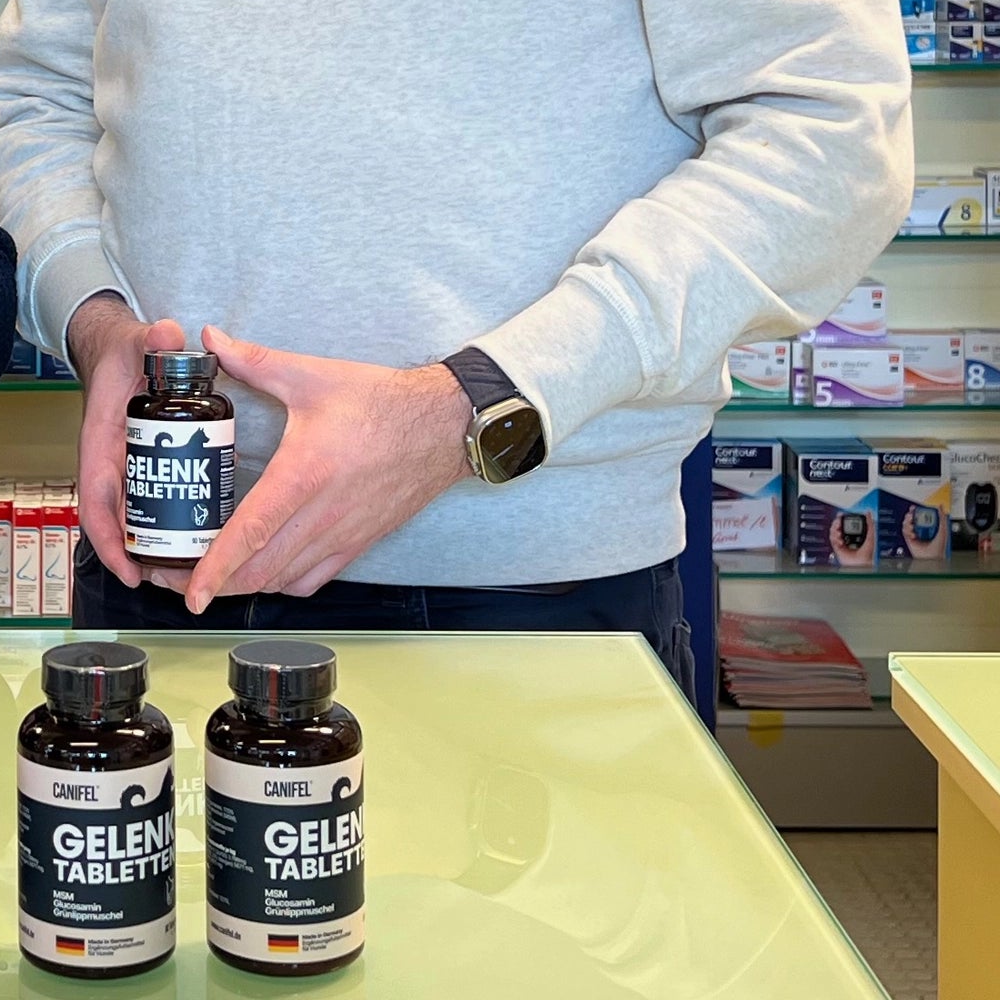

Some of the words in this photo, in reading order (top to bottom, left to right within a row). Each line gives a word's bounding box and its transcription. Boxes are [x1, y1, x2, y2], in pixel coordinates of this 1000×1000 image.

[961, 203, 971, 221] 8
[967, 363, 985, 389] 8
[815, 381, 833, 407] 5
[715, 447, 758, 457] Contour
[883, 453, 926, 463] Contour
[126, 454, 211, 483] GELENK
[809, 460, 853, 470] Contour
[126, 479, 211, 500] TABLETTEN
[53, 782, 99, 802] CANIFEL
[264, 780, 311, 798] CANIFEL
[53, 807, 175, 861] GELENK
[264, 802, 364, 857] GELEN
[53, 889, 74, 901] MSM
[264, 888, 288, 898] MSM
[53, 899, 101, 912] Glucosamin
[264, 898, 315, 908] Glucosamin
[264, 903, 335, 918] Grünlippmuschel
[53, 908, 123, 922] Grünlippmuschel
